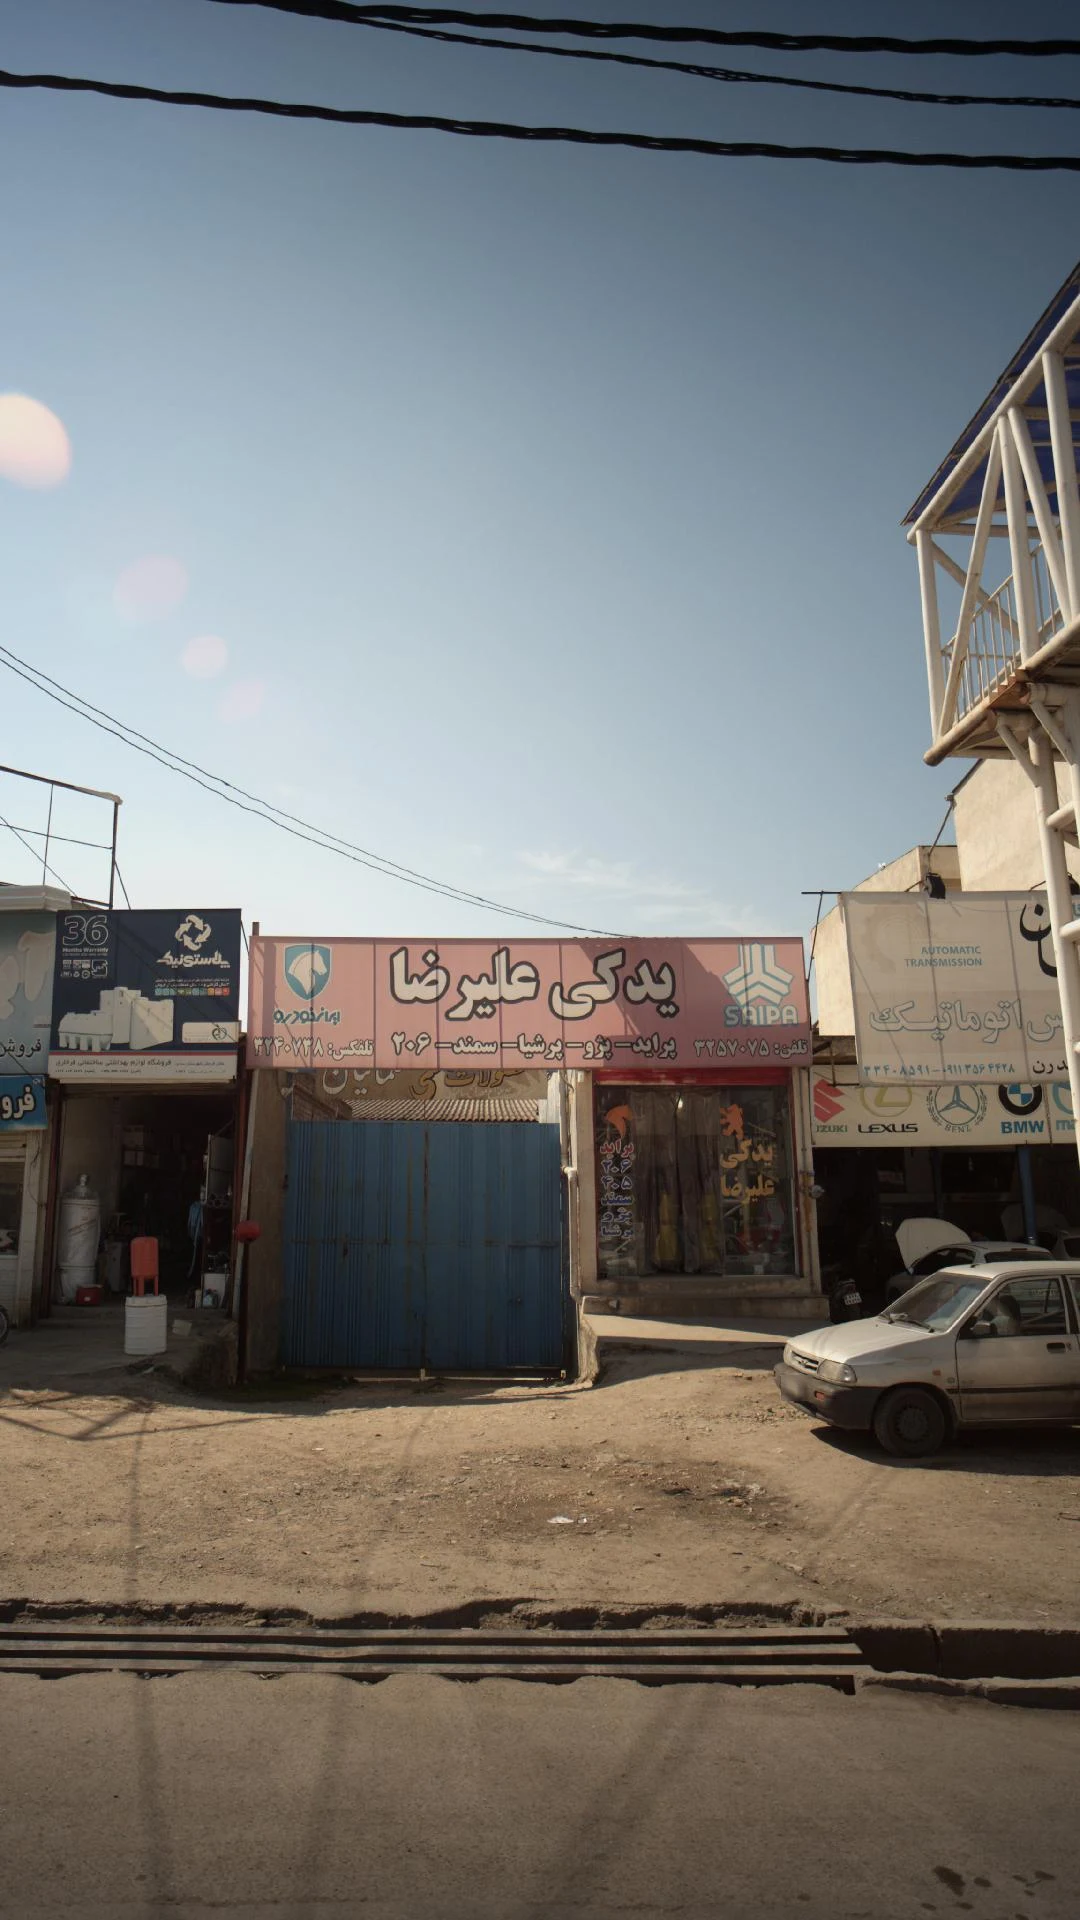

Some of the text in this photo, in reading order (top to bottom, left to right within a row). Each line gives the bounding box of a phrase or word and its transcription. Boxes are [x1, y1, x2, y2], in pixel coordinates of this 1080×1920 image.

[62, 914, 109, 946] 36
[921, 945, 981, 955] AUTOMATIC
[905, 957, 983, 967] TRANSMISSION
[389, 945, 680, 1022] یدکی علیرضا
[723, 1004, 800, 1028] SAIPA
[857, 1123, 919, 1134] LEXUS
[1000, 1120, 1044, 1134] BMW
